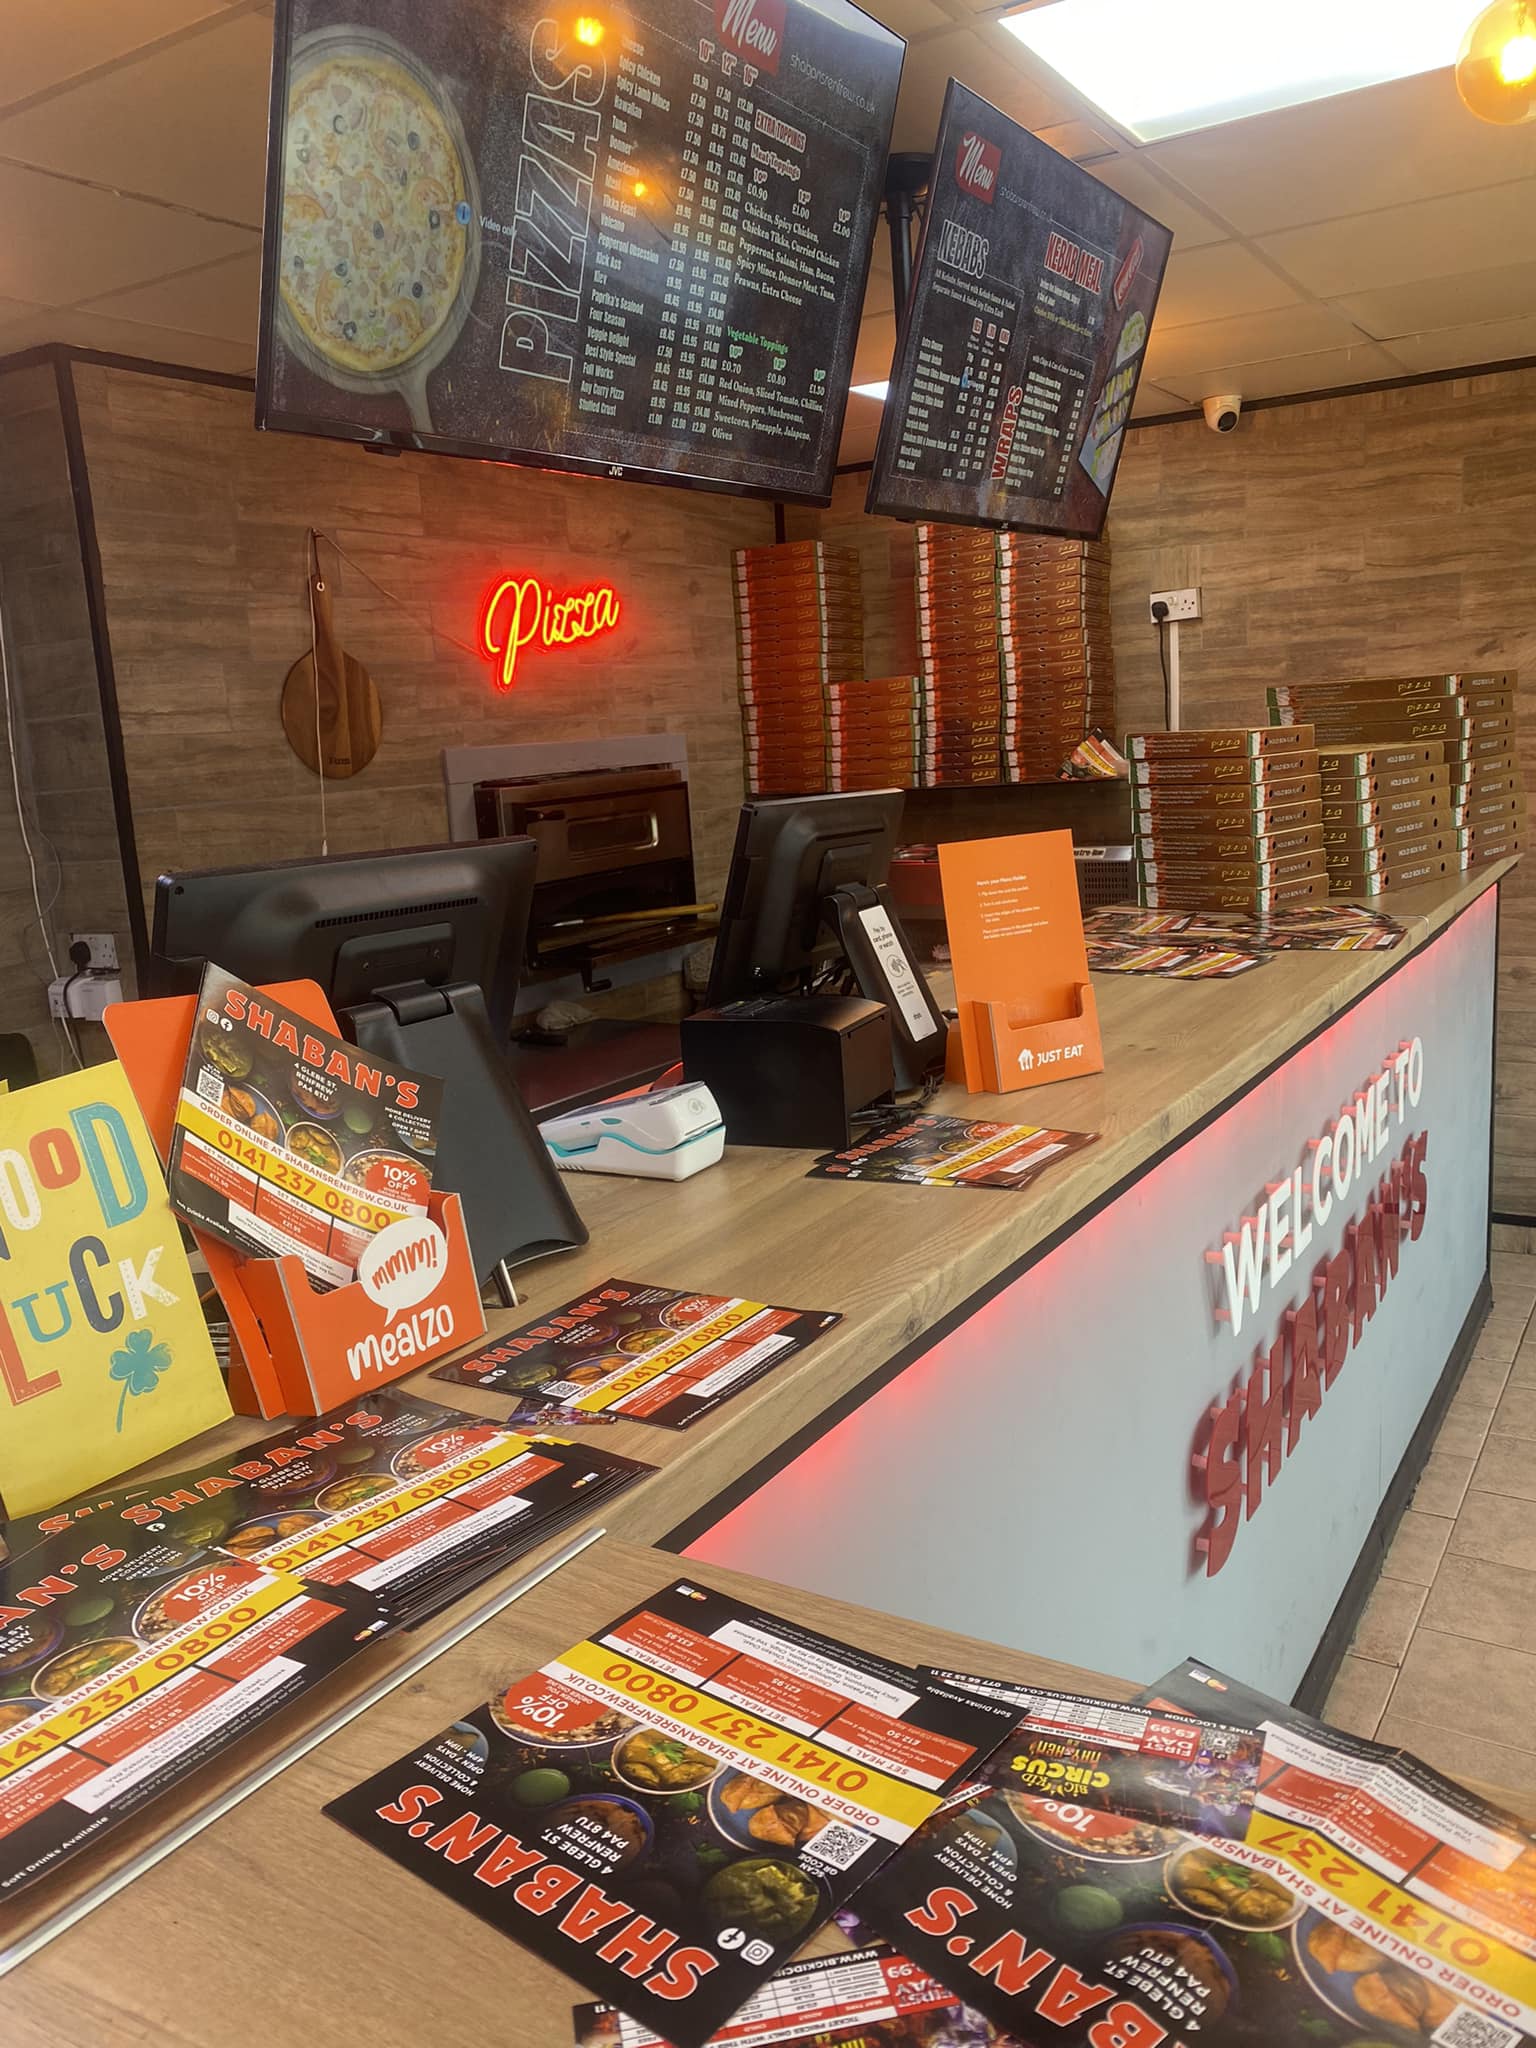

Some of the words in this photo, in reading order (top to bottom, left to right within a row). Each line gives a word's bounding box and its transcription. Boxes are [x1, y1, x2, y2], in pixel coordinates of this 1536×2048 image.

[722, 0, 777, 56] Menu
[636, 64, 661, 87] Chicken
[634, 83, 651, 103] Lamb
[650, 91, 671, 111] Mince
[612, 115, 627, 133] Tuna
[755, 109, 777, 138] EXTRA
[775, 120, 807, 153] TOPPINGS
[609, 134, 632, 155] Donner
[751, 143, 771, 166] Meat
[769, 152, 800, 181] Toppings
[959, 135, 994, 191] Menu
[499, 18, 606, 383] PIZZAS
[747, 183, 768, 200] £0.90
[792, 203, 810, 220] £1.00
[833, 222, 850, 238] £2.00
[480, 216, 500, 232] Video
[600, 213, 625, 232] Volcano
[744, 202, 773, 225] Chicken,
[774, 215, 793, 233] Spicy
[793, 222, 819, 243] Chicken,
[598, 232, 629, 254] Pepperoni
[629, 242, 659, 264] Obsession
[742, 220, 770, 240] Chicken
[770, 230, 790, 248] Tikka,
[791, 240, 816, 258] Curried
[816, 251, 840, 268] Chicken
[937, 219, 990, 279] KEBABS
[595, 252, 610, 267] Kick
[609, 257, 622, 271] Ass
[736, 255, 757, 273] Spicy
[757, 262, 778, 279] Mince,
[778, 271, 801, 289] Donner
[801, 281, 819, 297] Meat,
[776, 251, 799, 266] Salami,
[816, 268, 835, 285] Bacon,
[1044, 231, 1080, 281] KEBAB
[1075, 249, 1105, 295] MEAL
[592, 289, 620, 308] Paprika's
[620, 297, 644, 315] Seafood
[734, 272, 761, 292] Prawns,
[761, 282, 780, 298] Extra
[780, 290, 802, 306] Cheese
[589, 307, 603, 321] Four
[603, 311, 626, 328] Season
[587, 326, 608, 344] Veggie
[608, 332, 629, 348] Delight
[727, 326, 758, 345] Vegetable
[760, 336, 789, 354] Toppings
[585, 344, 598, 358] Desi
[598, 348, 615, 363] Style
[615, 352, 636, 367] Special
[583, 362, 595, 376] Full
[595, 366, 614, 380] Works
[721, 361, 742, 375] £0.70
[767, 372, 786, 386] £0.80
[581, 380, 593, 394] Any
[593, 384, 609, 398] Curry
[609, 387, 625, 400] Pizza
[719, 377, 733, 391] Red
[733, 381, 754, 395] Onion,
[755, 385, 776, 400] Sliced
[776, 391, 800, 406] Tomato,
[800, 398, 824, 413] Chillies,
[579, 398, 600, 414] Stuffed
[600, 403, 616, 417] Crust
[718, 394, 739, 409] Mixed
[739, 399, 767, 416] Peppers,
[768, 405, 804, 424] Mushrooms,
[712, 427, 733, 441] Olives
[714, 410, 751, 429] Sweetcorn,
[751, 418, 783, 436] Pineapple,
[992, 385, 1023, 480] WRAPS
[609, 466, 623, 476] JVC
[485, 578, 620, 685] Pizza
[1406, 703, 1441, 713] pizza
[1412, 723, 1447, 734] pizza
[224, 989, 421, 1109] SHABAN'S
[1037, 1049, 1062, 1067] JUST
[1064, 1044, 1084, 1059] EAT
[0, 1101, 149, 1230] OOD
[199, 1102, 233, 1128] ORDER
[234, 1121, 269, 1148] ONLINE
[271, 1144, 284, 1159] AT
[284, 1151, 409, 1213] SHABANSRENFREW.CO.UK
[217, 1129, 267, 1171] 0141
[274, 1163, 317, 1195] 237
[324, 1191, 391, 1230] 0800
[382, 1164, 417, 1186] 10%
[387, 1180, 409, 1192] OFF
[1223, 1067, 1391, 1337] WELCOME
[1393, 1036, 1424, 1125] TO
[0, 1234, 181, 1406] LUCK
[463, 1289, 630, 1373] SHABAN'S
[610, 1366, 660, 1392] 0141
[656, 1344, 692, 1365] 237
[692, 1313, 743, 1343] 0800
[1206, 1129, 1429, 1579] SHABAN'S
[422, 1434, 465, 1454] 10%
[120, 1410, 383, 1526] SHABAN'S
[267, 1533, 339, 1572] 0141
[346, 1500, 401, 1533] 237
[411, 1459, 491, 1500] 0800
[172, 1573, 227, 1602] 10%
[154, 1607, 257, 1671] 0800
[665, 1632, 694, 1647] £33.95
[538, 1693, 569, 1710] OFF
[602, 1663, 699, 1714] 0800
[926, 1686, 965, 1703] Available
[1013, 1685, 1152, 1716] WWW.BIGKIDCIRCUS.CO.UK
[513, 1695, 565, 1729] 10%
[563, 1672, 739, 1763] SHABANSRENFREW.CO.UK
[965, 1700, 993, 1712] Drinks
[993, 1708, 1013, 1718] Soft
[1164, 1713, 1214, 1727] LOCATION
[700, 1712, 779, 1749] 237
[886, 1729, 921, 1746] £12.50
[1148, 1735, 1194, 1749] DAY
[1150, 1723, 1197, 1739] £9.99
[1228, 1726, 1255, 1737] TIME
[737, 1758, 758, 1770] AT
[1144, 1741, 1192, 1758] FIRST
[761, 1766, 820, 1799] ONLINE
[776, 1743, 868, 1793] 0141
[1011, 1755, 1111, 1788] CIRCUS
[576, 1816, 604, 1833] 8TU
[822, 1795, 880, 1827] ORDER
[541, 1828, 559, 1845] ST,
[557, 1824, 622, 1863] RENFREW
[599, 1829, 630, 1849] PA4
[558, 1842, 601, 1869] GLEBE
[1259, 1830, 1360, 1889] 237
[601, 1867, 614, 1875] 4
[376, 1782, 720, 2001] SHABAN'S
[1367, 1888, 1491, 1968] 0141
[904, 1886, 1184, 2048] BAN'S
